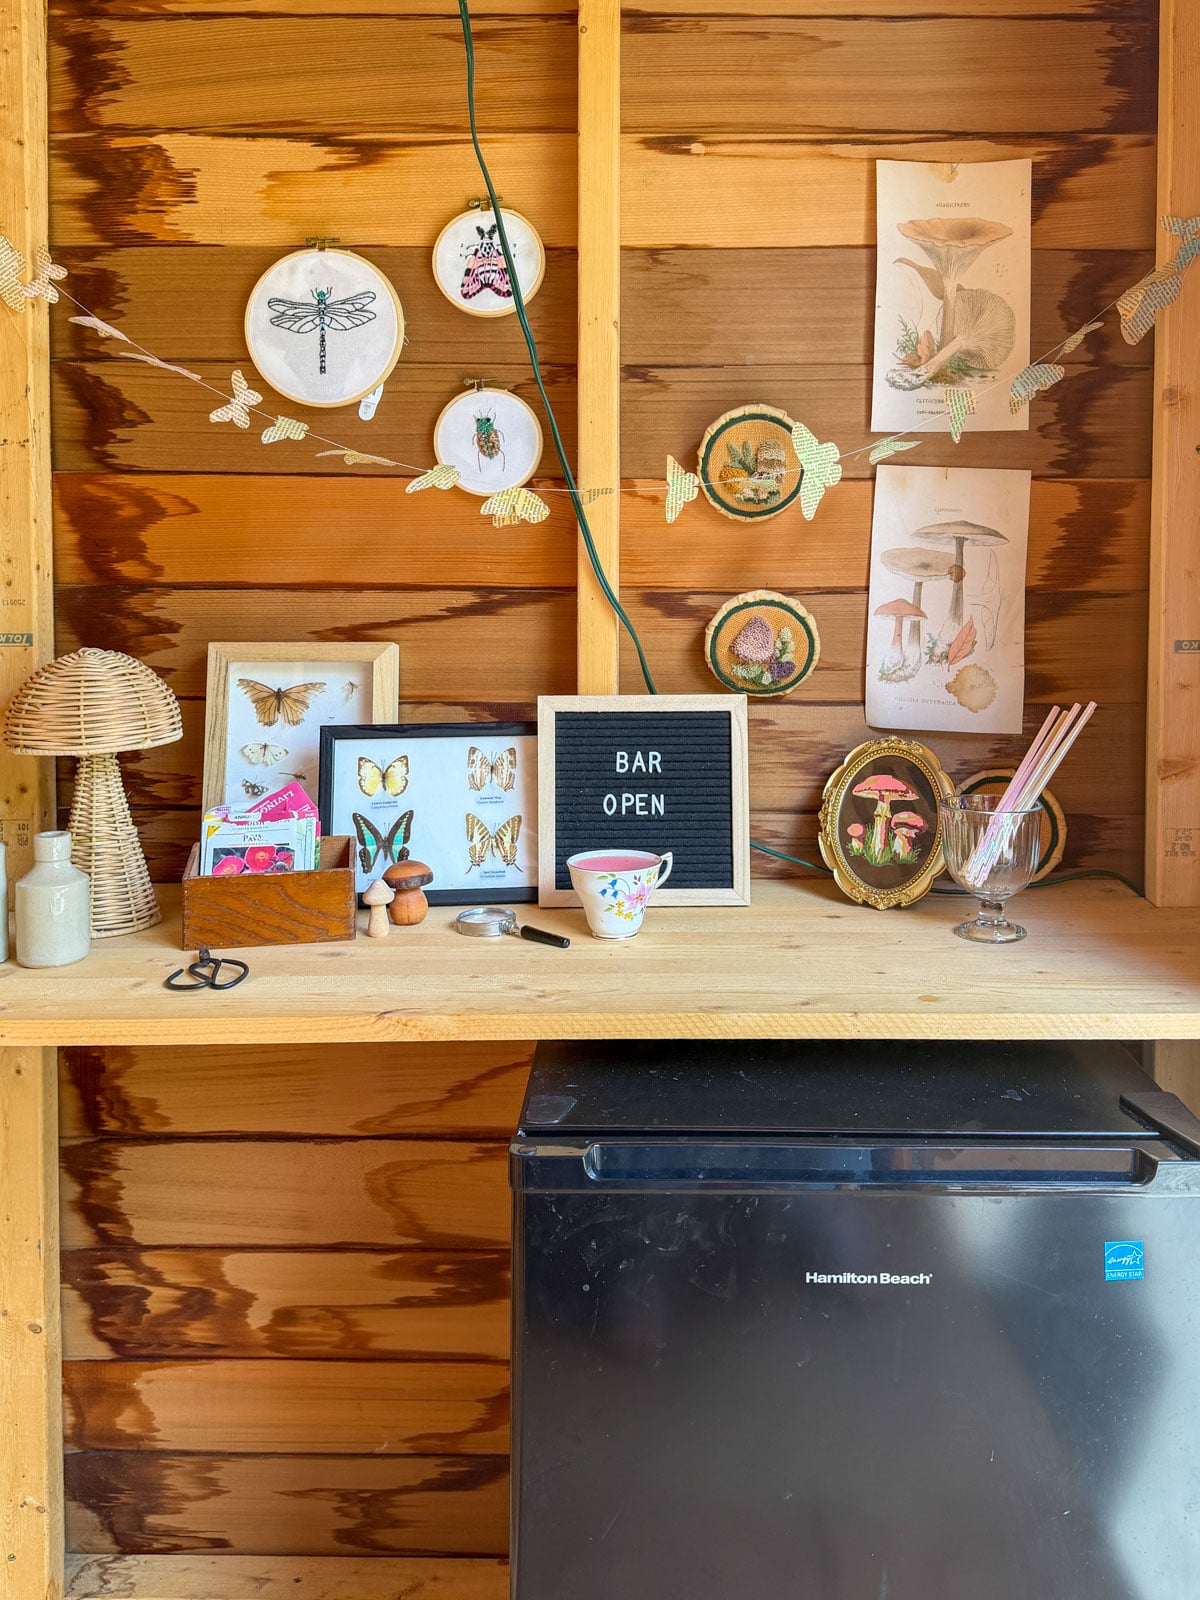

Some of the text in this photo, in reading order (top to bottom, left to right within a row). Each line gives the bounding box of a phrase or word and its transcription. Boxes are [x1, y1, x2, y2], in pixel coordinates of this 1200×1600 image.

[616, 751, 662, 773] BAR
[603, 793, 664, 816] OPEN
[805, 1271, 931, 1285] Hamilton Beach
[1106, 1270, 1142, 1279] ENERGY STAR
